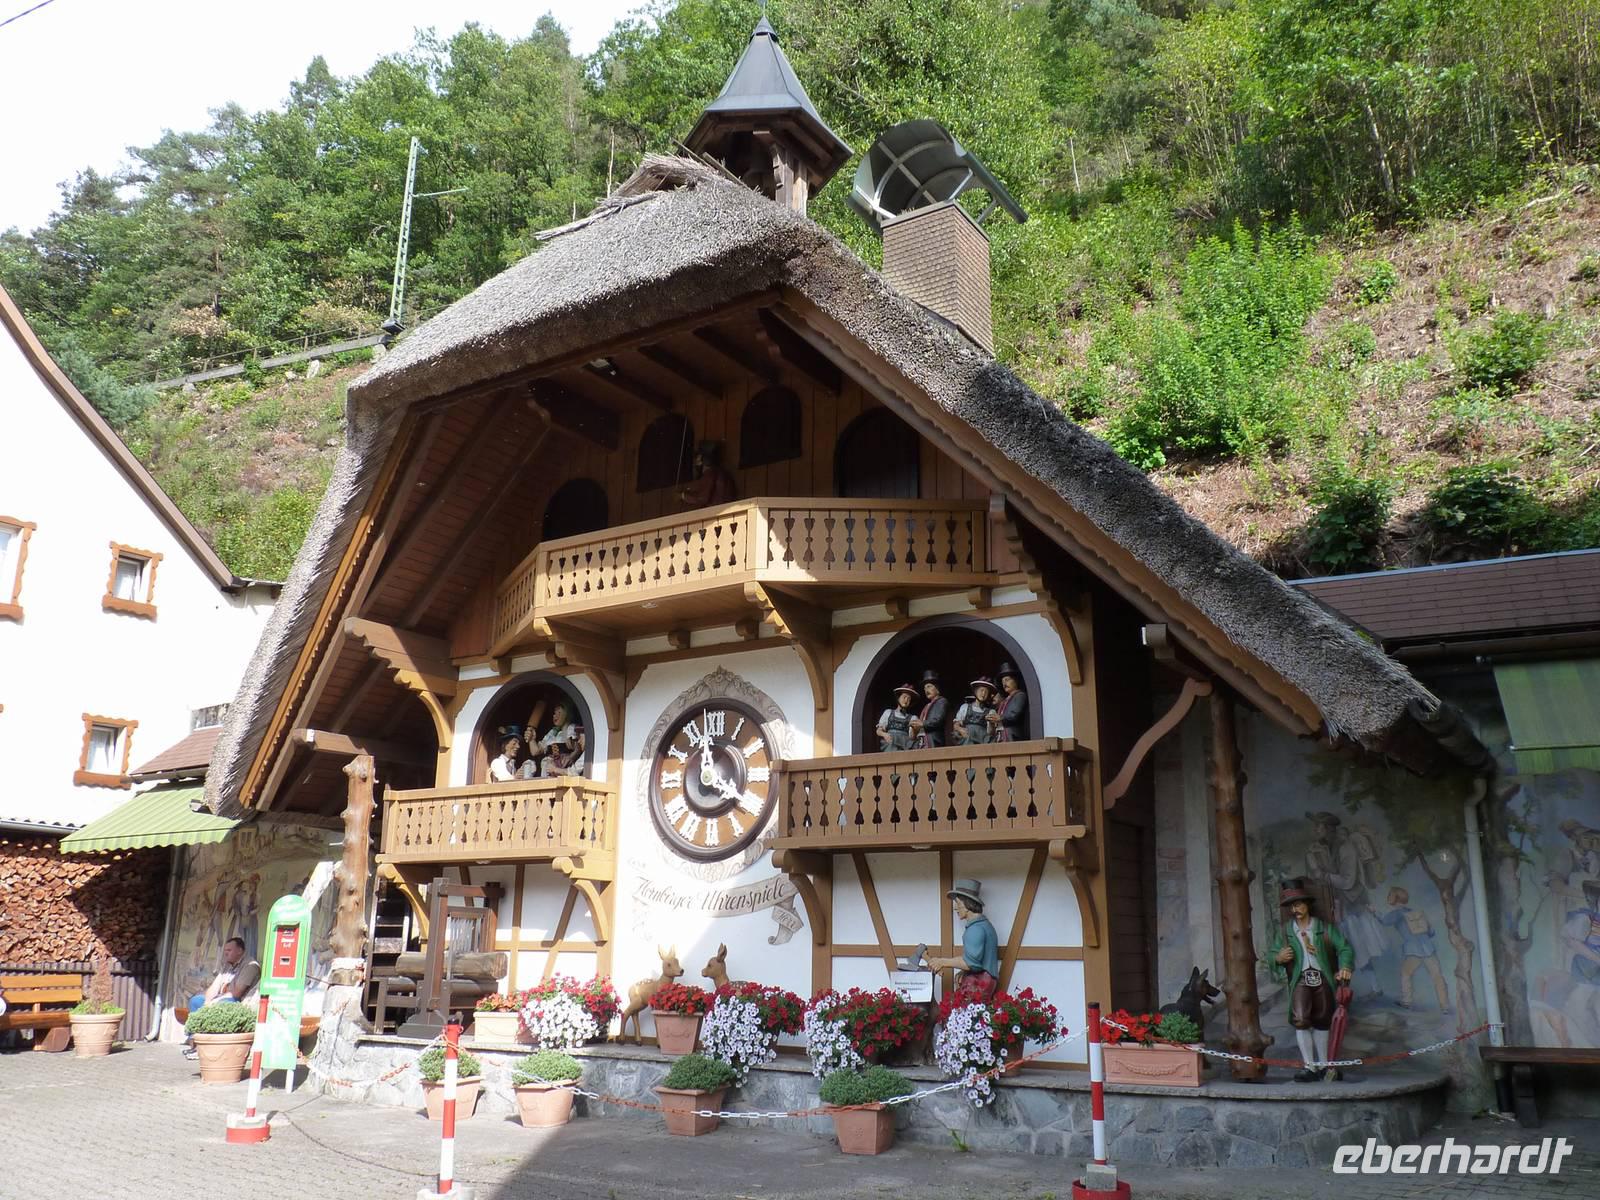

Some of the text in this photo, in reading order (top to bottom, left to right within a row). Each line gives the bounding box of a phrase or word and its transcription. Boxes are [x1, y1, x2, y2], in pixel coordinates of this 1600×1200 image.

[683, 719, 702, 748] XI
[707, 711, 725, 737] XII
[731, 717, 745, 741] I
[667, 744, 688, 764] X
[699, 876, 785, 912] Uhrenspiele
